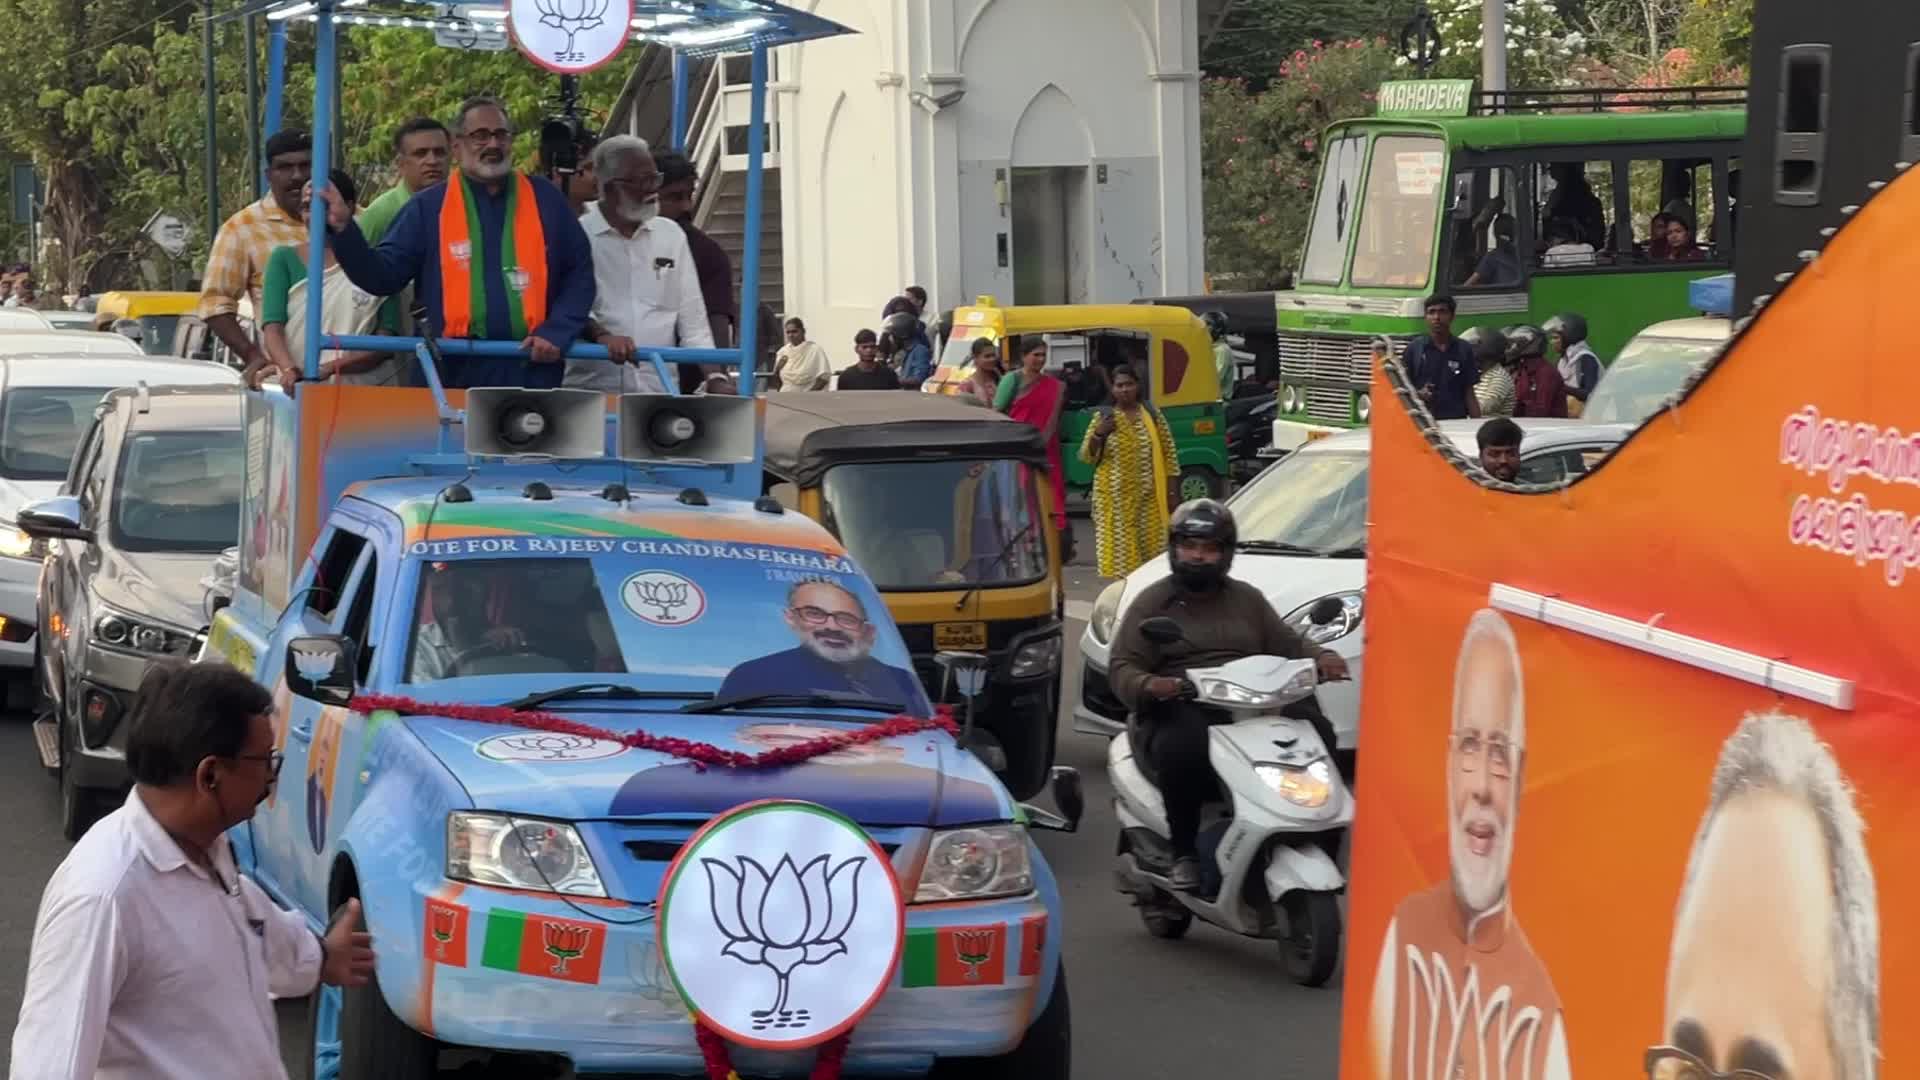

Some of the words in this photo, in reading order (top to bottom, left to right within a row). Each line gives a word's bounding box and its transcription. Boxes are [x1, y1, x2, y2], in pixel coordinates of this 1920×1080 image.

[1379, 83, 1466, 113] MAHADEVA
[402, 539, 462, 557] OTE
[465, 538, 520, 553] FOR
[528, 539, 616, 554] RAJEEV
[622, 540, 858, 574] CHANDRASEKHARA
